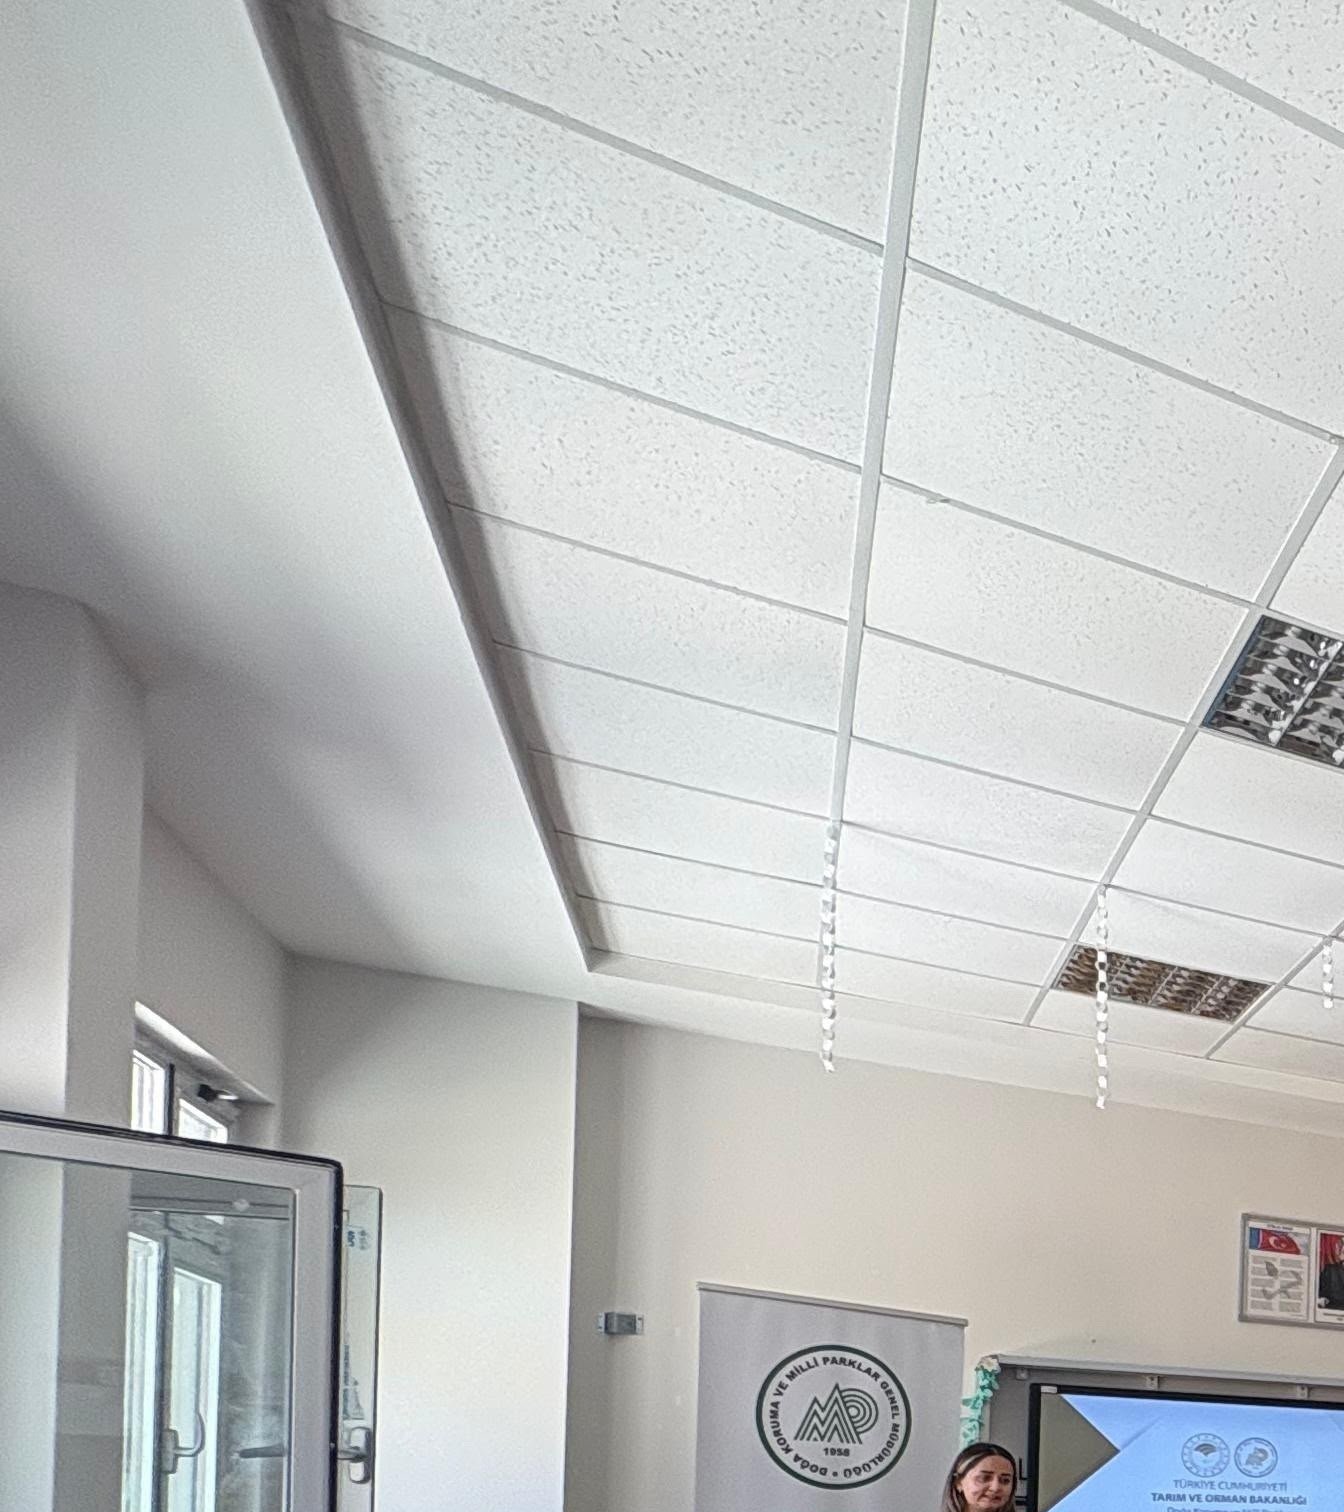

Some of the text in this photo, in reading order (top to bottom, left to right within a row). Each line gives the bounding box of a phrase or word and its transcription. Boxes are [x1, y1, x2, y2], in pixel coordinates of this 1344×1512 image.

[785, 1356, 820, 1382] MİLLİ
[822, 1356, 882, 1382] PARKLAR
[773, 1380, 789, 1397] VE
[880, 1380, 900, 1420] GENEL
[769, 1400, 794, 1455] KORUMA
[793, 1453, 828, 1477] DOĞA
[1151, 1493, 1307, 1505] TARIM VE ORMAN BAKANLIĞI
